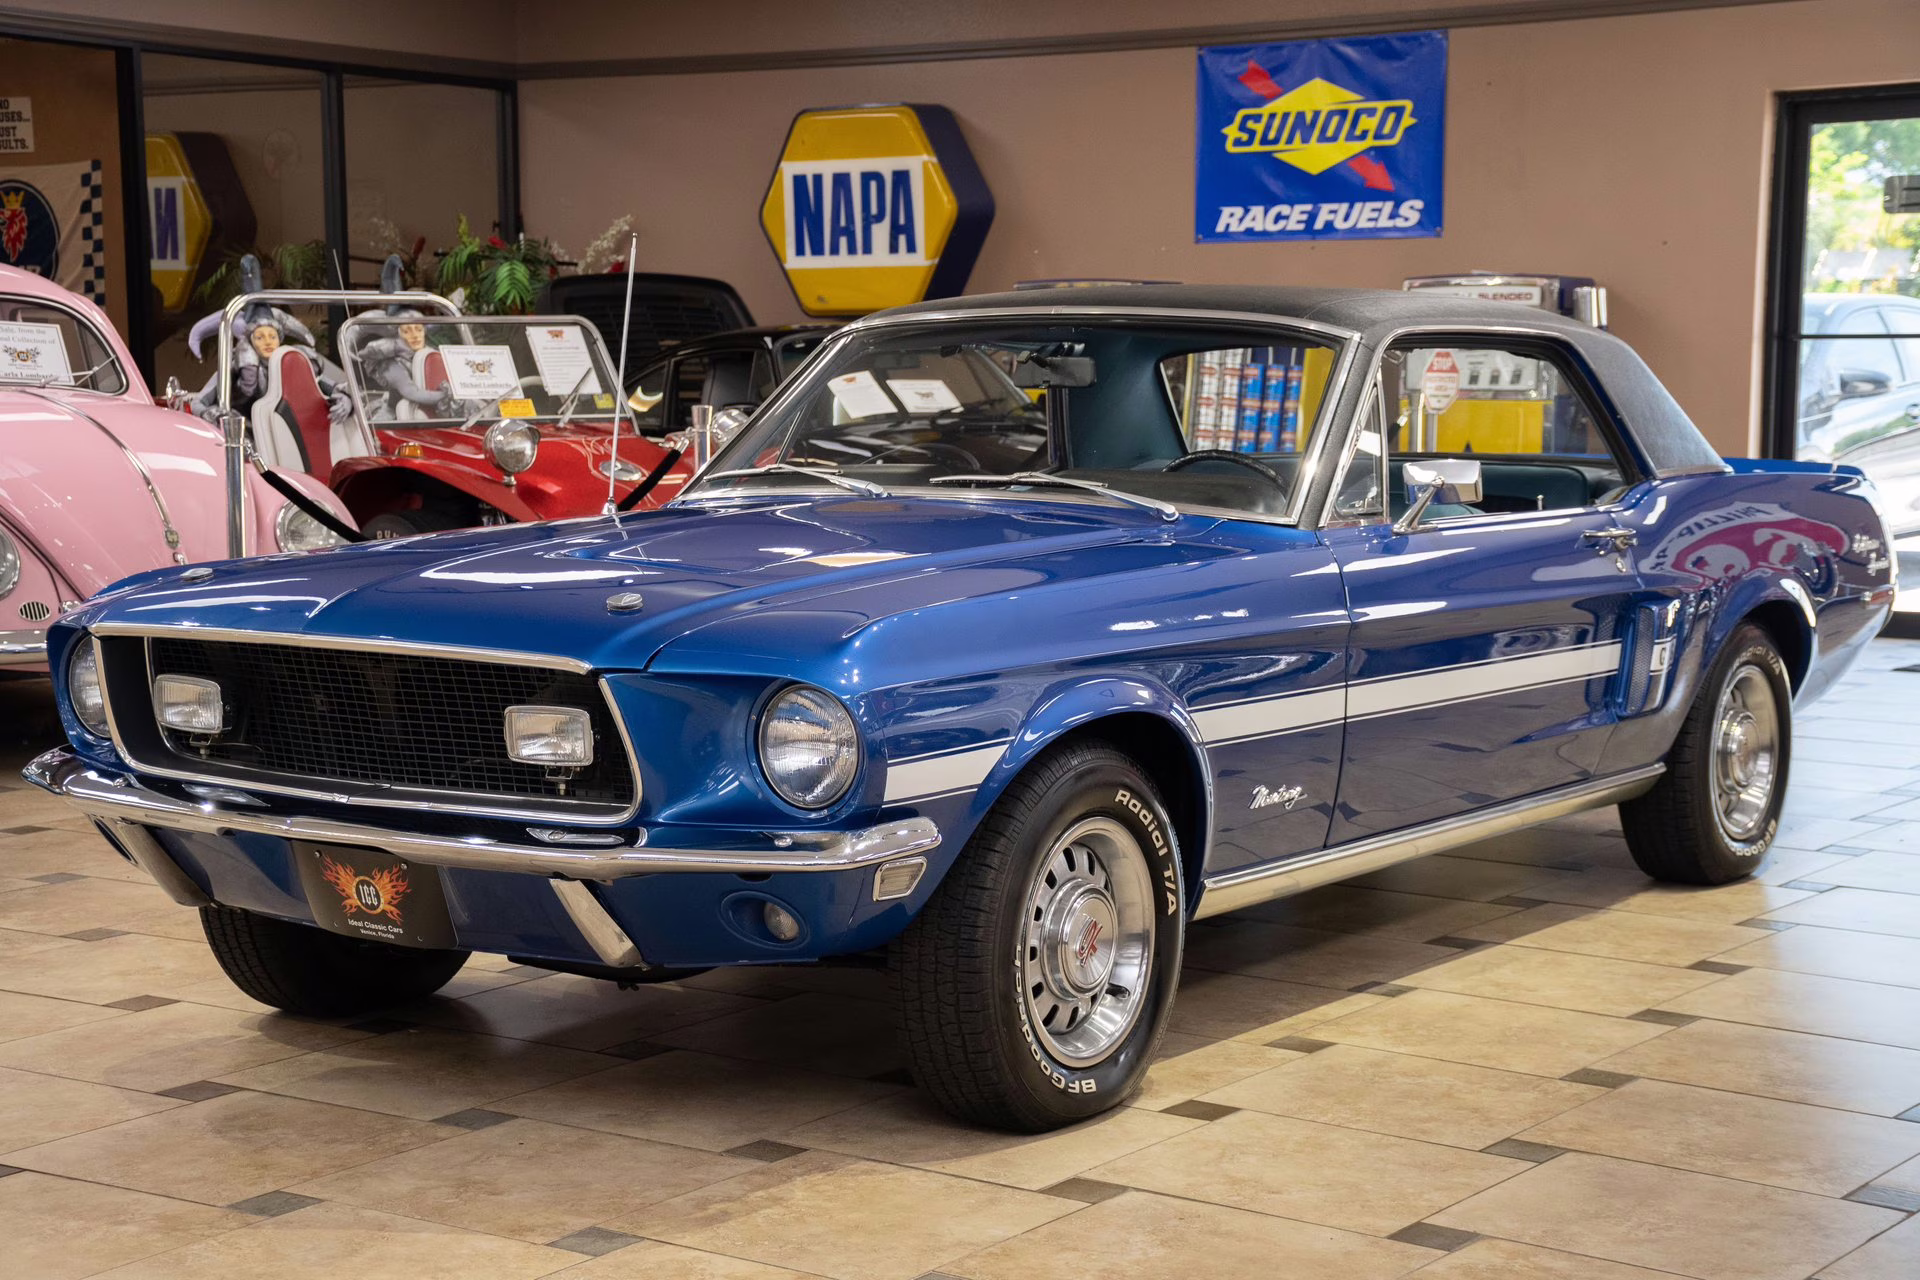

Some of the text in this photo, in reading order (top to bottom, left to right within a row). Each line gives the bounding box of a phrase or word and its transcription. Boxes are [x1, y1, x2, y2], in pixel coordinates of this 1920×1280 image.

[1231, 106, 1407, 147] SUNOCO
[793, 170, 917, 256] NAPA
[1215, 199, 1425, 233] RACE FUELS
[1433, 356, 1453, 371] STOP
[1114, 789, 1177, 915] Radial T/A
[347, 918, 404, 934] Ideal Classic Cars
